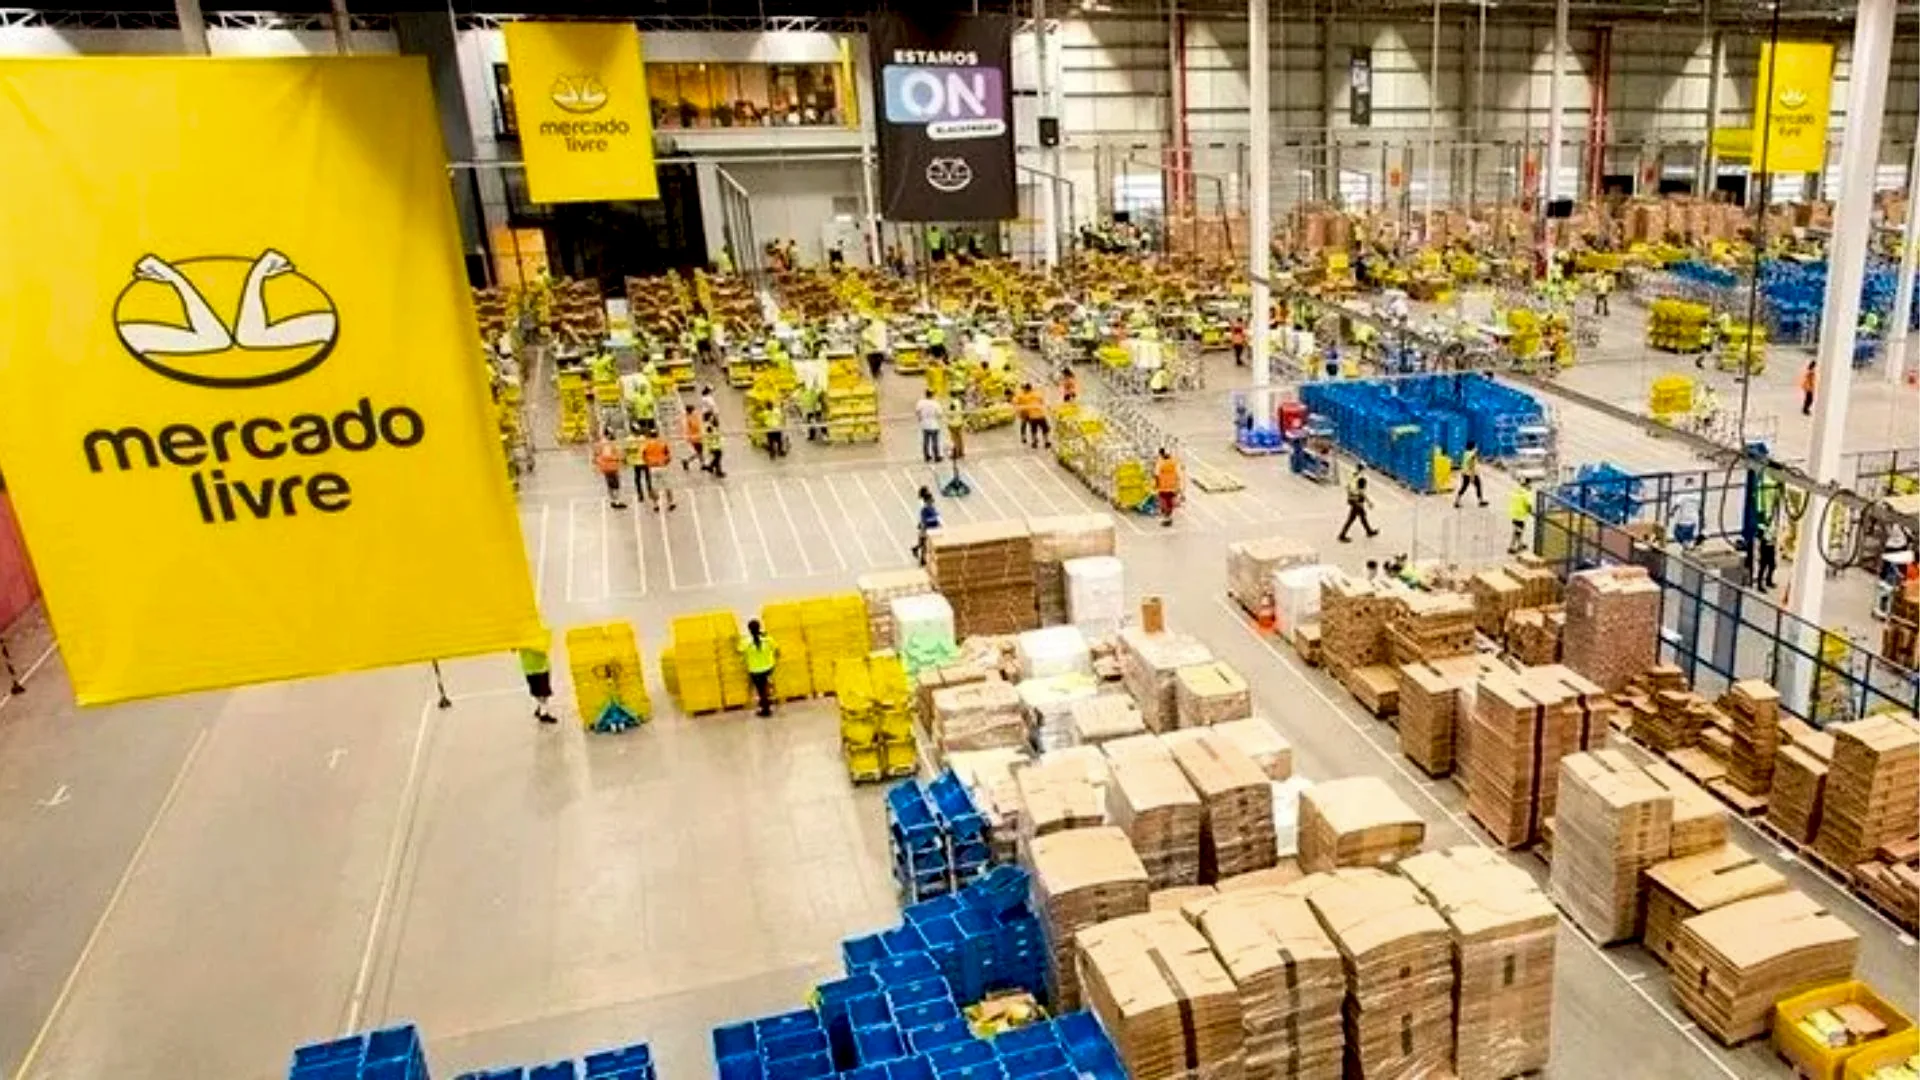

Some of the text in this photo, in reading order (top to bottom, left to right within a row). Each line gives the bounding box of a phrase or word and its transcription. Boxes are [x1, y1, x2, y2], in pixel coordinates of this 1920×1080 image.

[893, 49, 979, 65] ESTAMOS
[902, 71, 986, 117] ON
[540, 118, 629, 136] mercado
[565, 137, 608, 152] livre
[84, 397, 424, 472] mercado
[191, 471, 352, 523] livre
